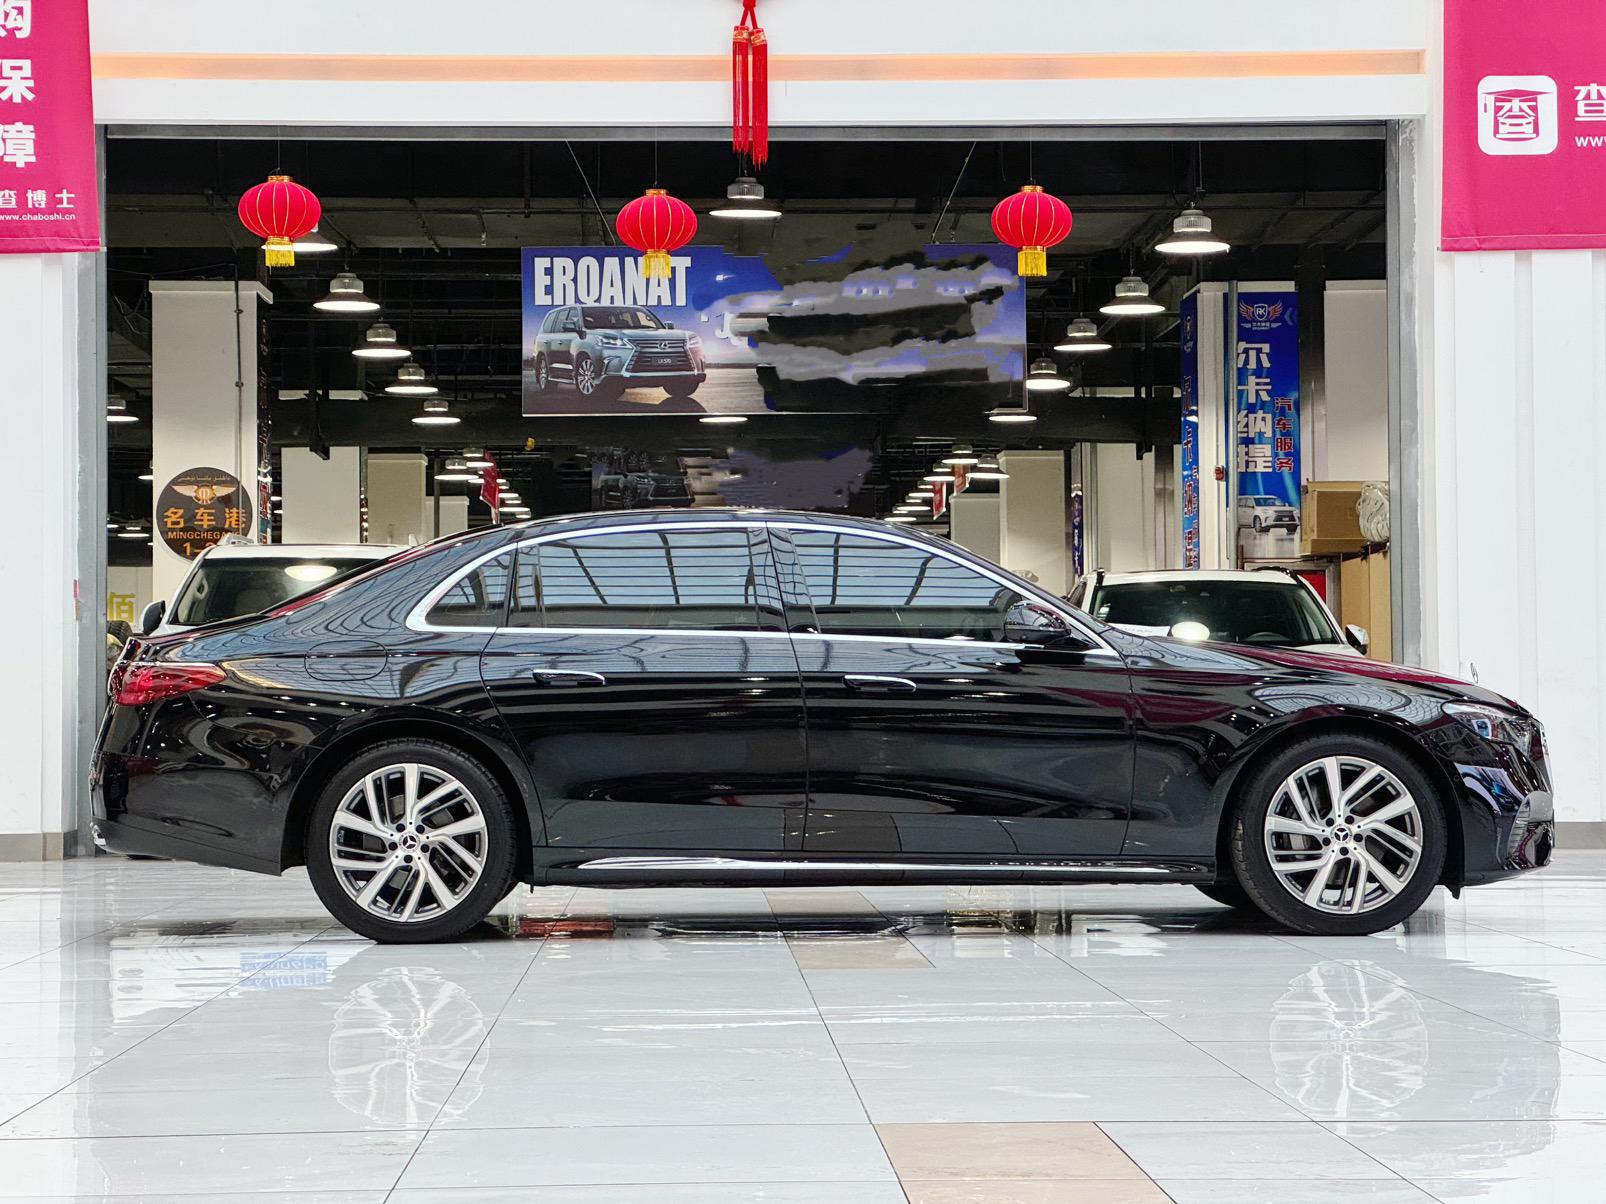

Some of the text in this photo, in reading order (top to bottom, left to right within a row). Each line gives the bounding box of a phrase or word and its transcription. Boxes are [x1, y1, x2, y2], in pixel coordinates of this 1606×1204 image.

[1575, 135, 1606, 147] ww
[0, 188, 76, 208] 查博士
[1274, 396, 1294, 473] 汽车服务
[164, 507, 247, 529] 名车港
